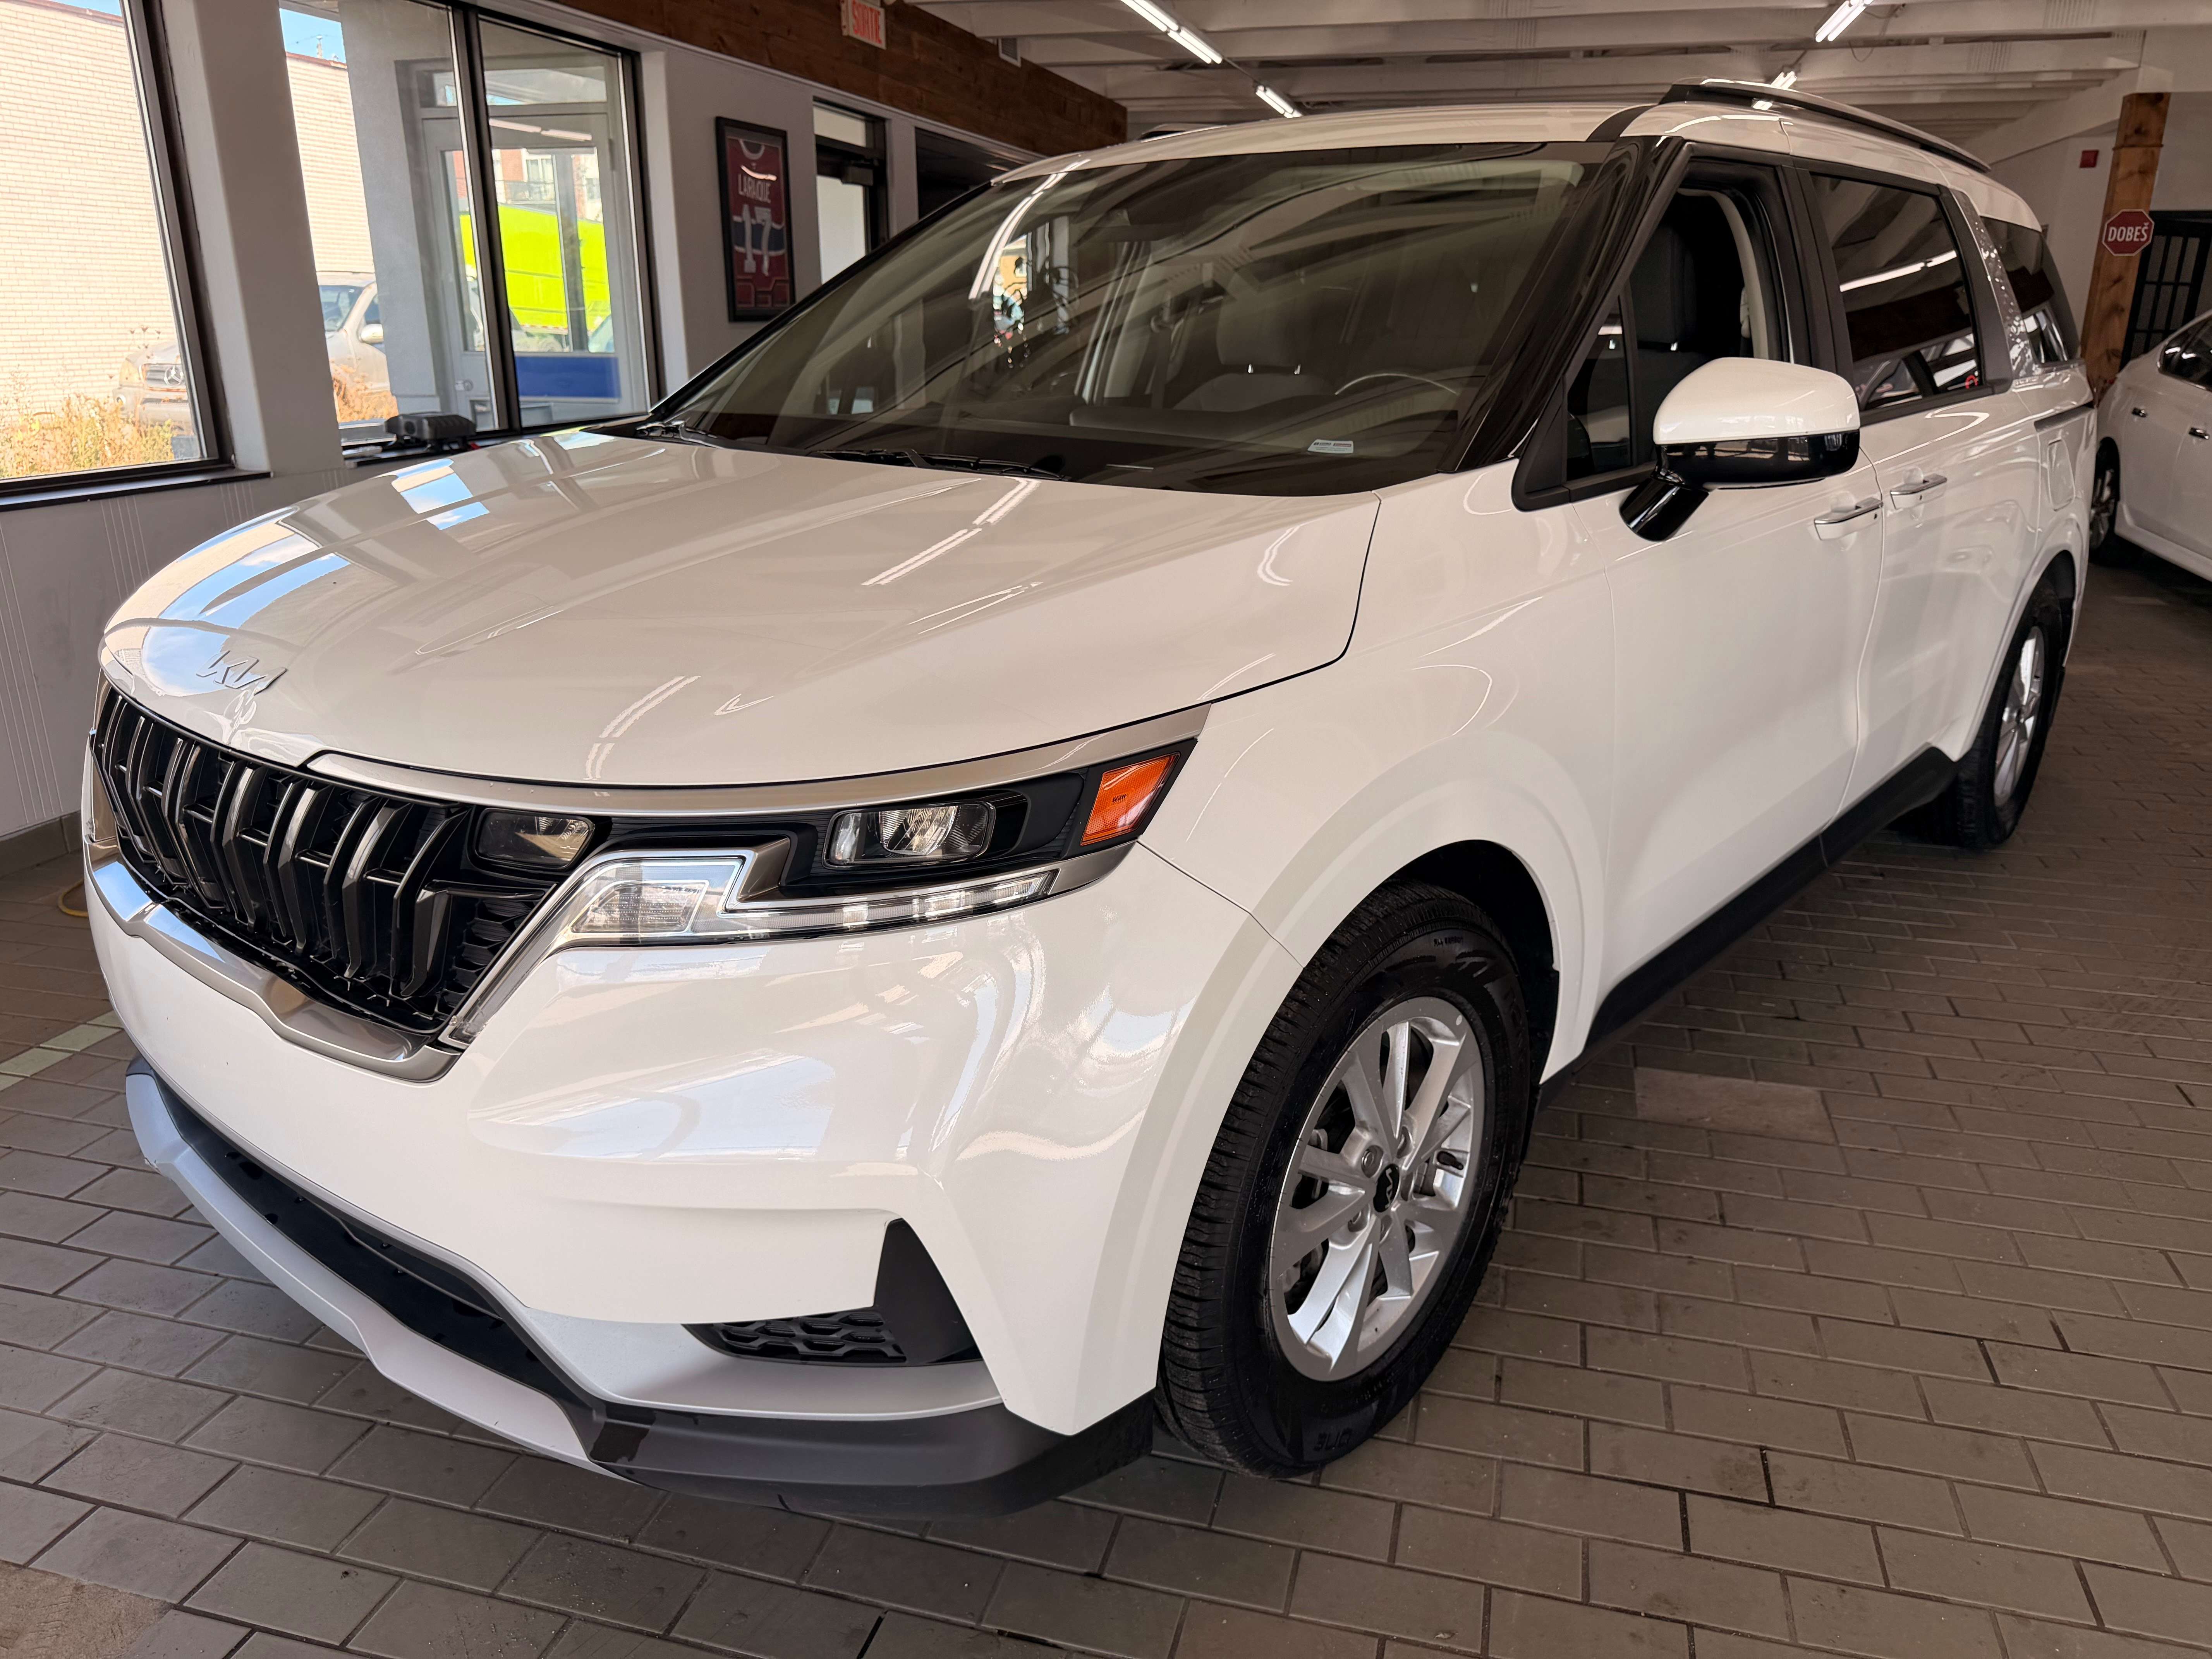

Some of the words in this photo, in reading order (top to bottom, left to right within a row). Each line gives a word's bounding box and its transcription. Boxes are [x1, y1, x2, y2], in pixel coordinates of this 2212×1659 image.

[852, 0, 882, 44] SORTIE
[742, 204, 772, 276] 17
[2107, 222, 2150, 242] DOBEŠ
